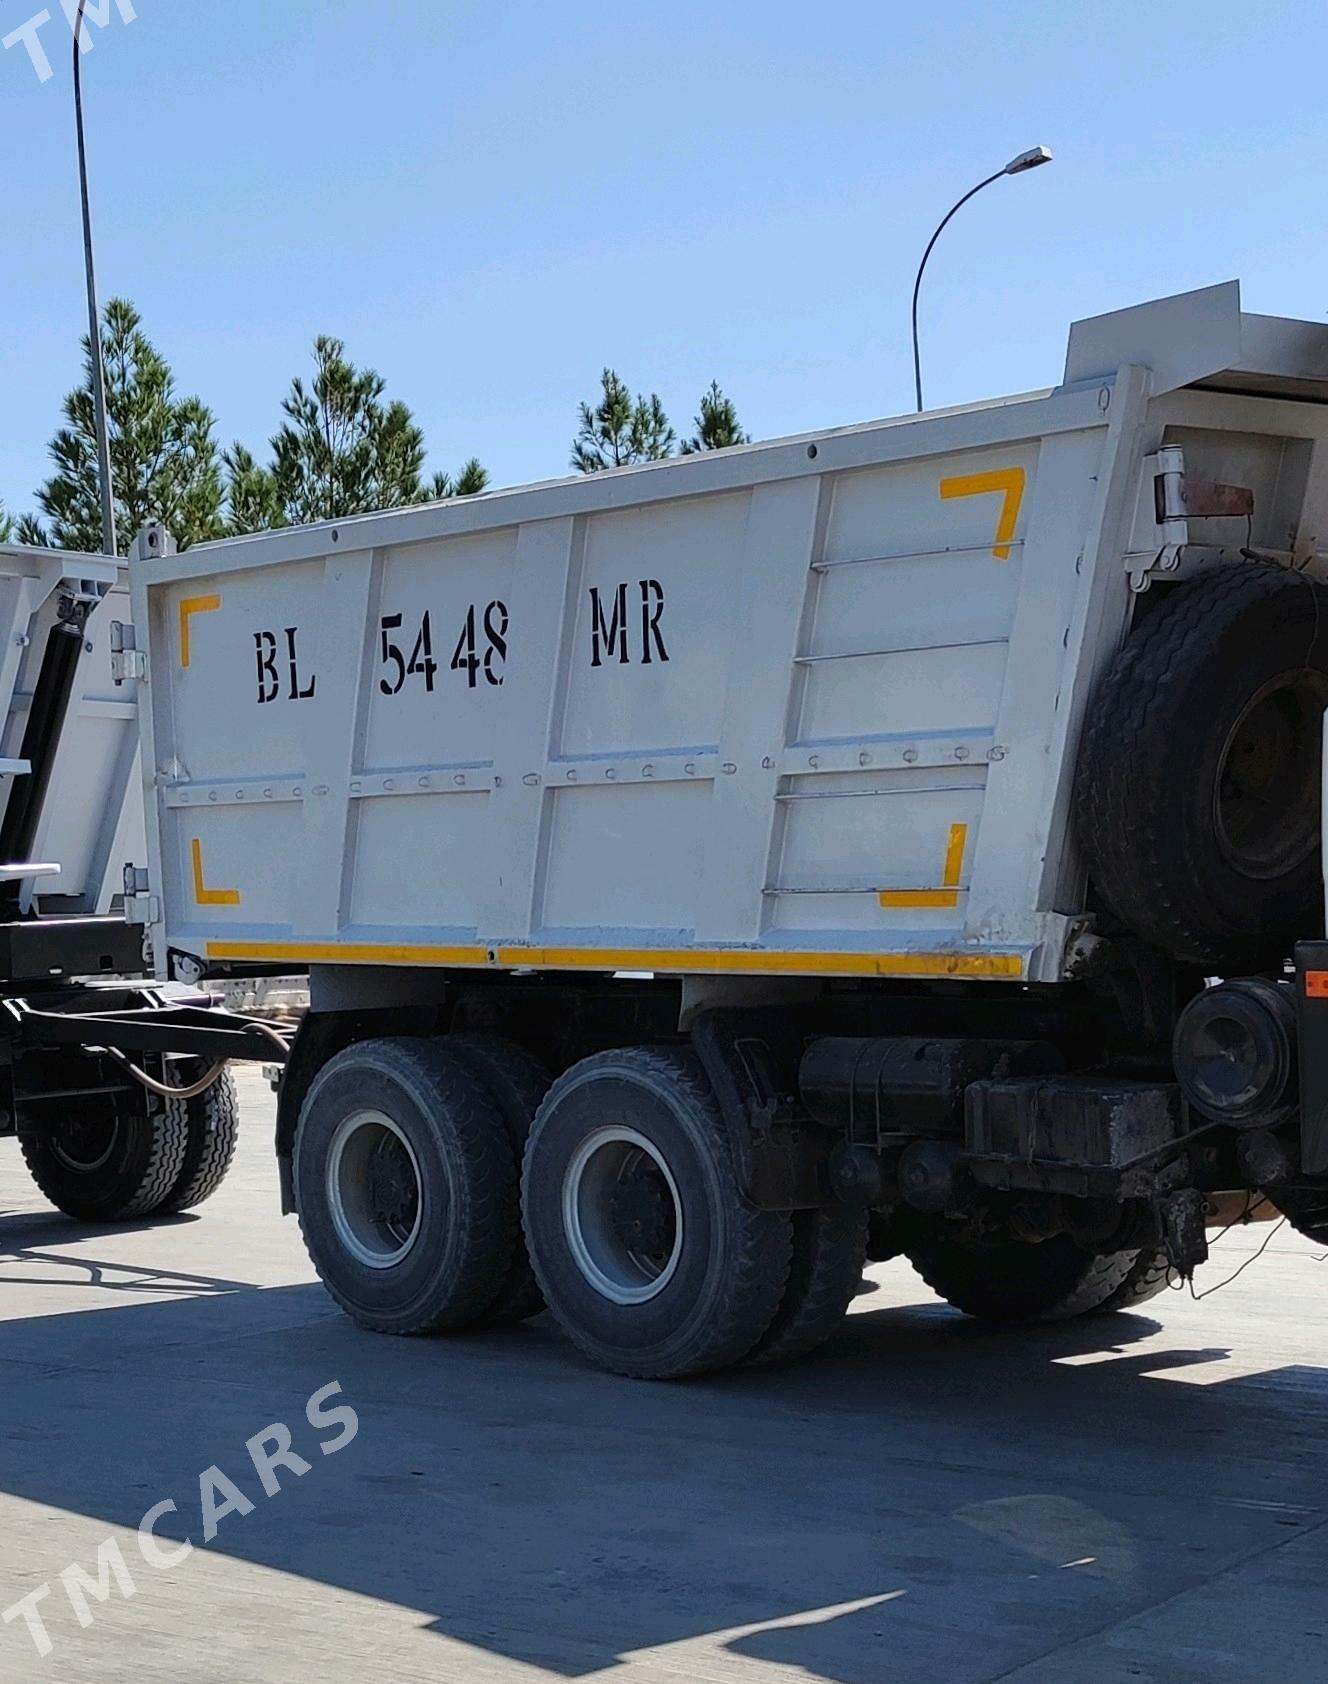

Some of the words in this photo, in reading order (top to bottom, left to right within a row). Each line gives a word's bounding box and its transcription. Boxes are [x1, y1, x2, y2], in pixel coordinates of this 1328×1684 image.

[253, 626, 316, 704] BL
[379, 600, 510, 696] 5448
[589, 578, 670, 668] MR
